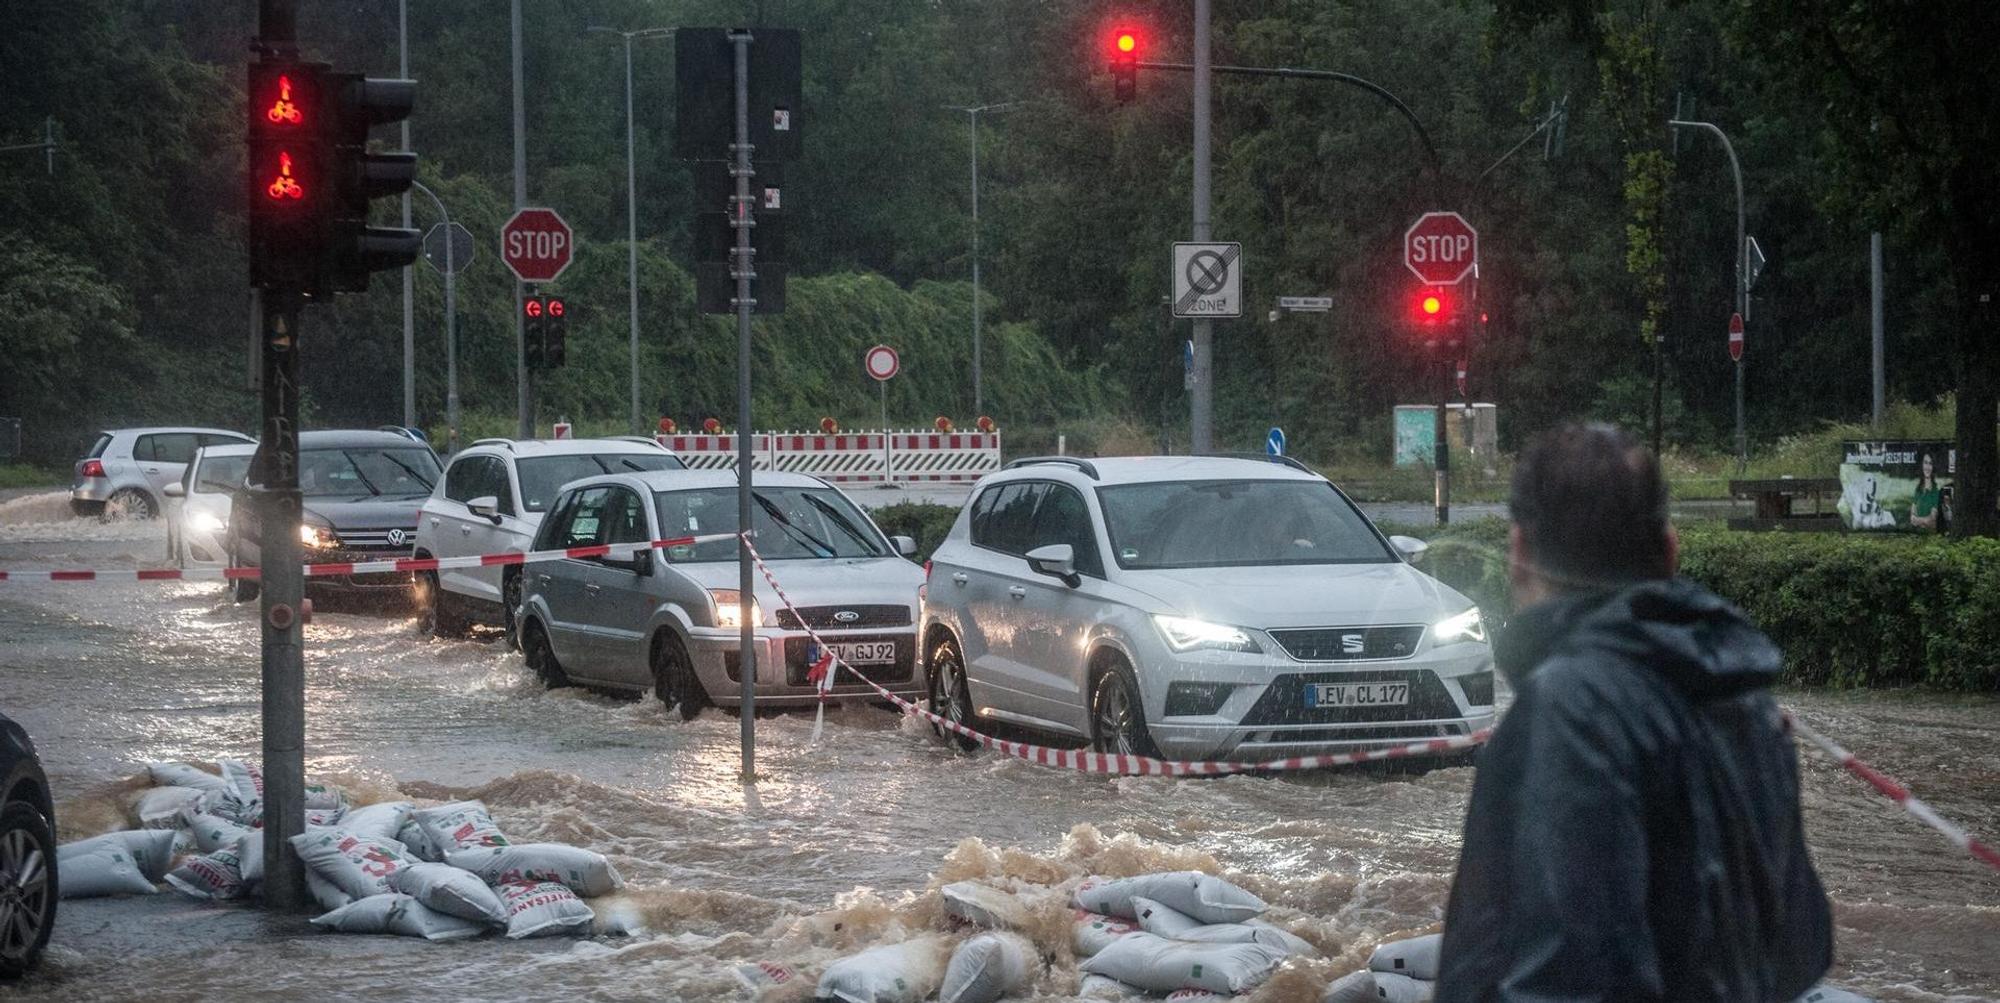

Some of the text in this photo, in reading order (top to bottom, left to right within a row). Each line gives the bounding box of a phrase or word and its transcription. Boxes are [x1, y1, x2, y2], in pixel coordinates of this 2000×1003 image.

[508, 230, 565, 259] STOP
[1412, 234, 1470, 262] STOP
[1190, 299, 1225, 311] ZONE
[856, 644, 874, 660] GJ
[876, 644, 893, 659] 92
[1316, 684, 1407, 705] LEV CL 177
